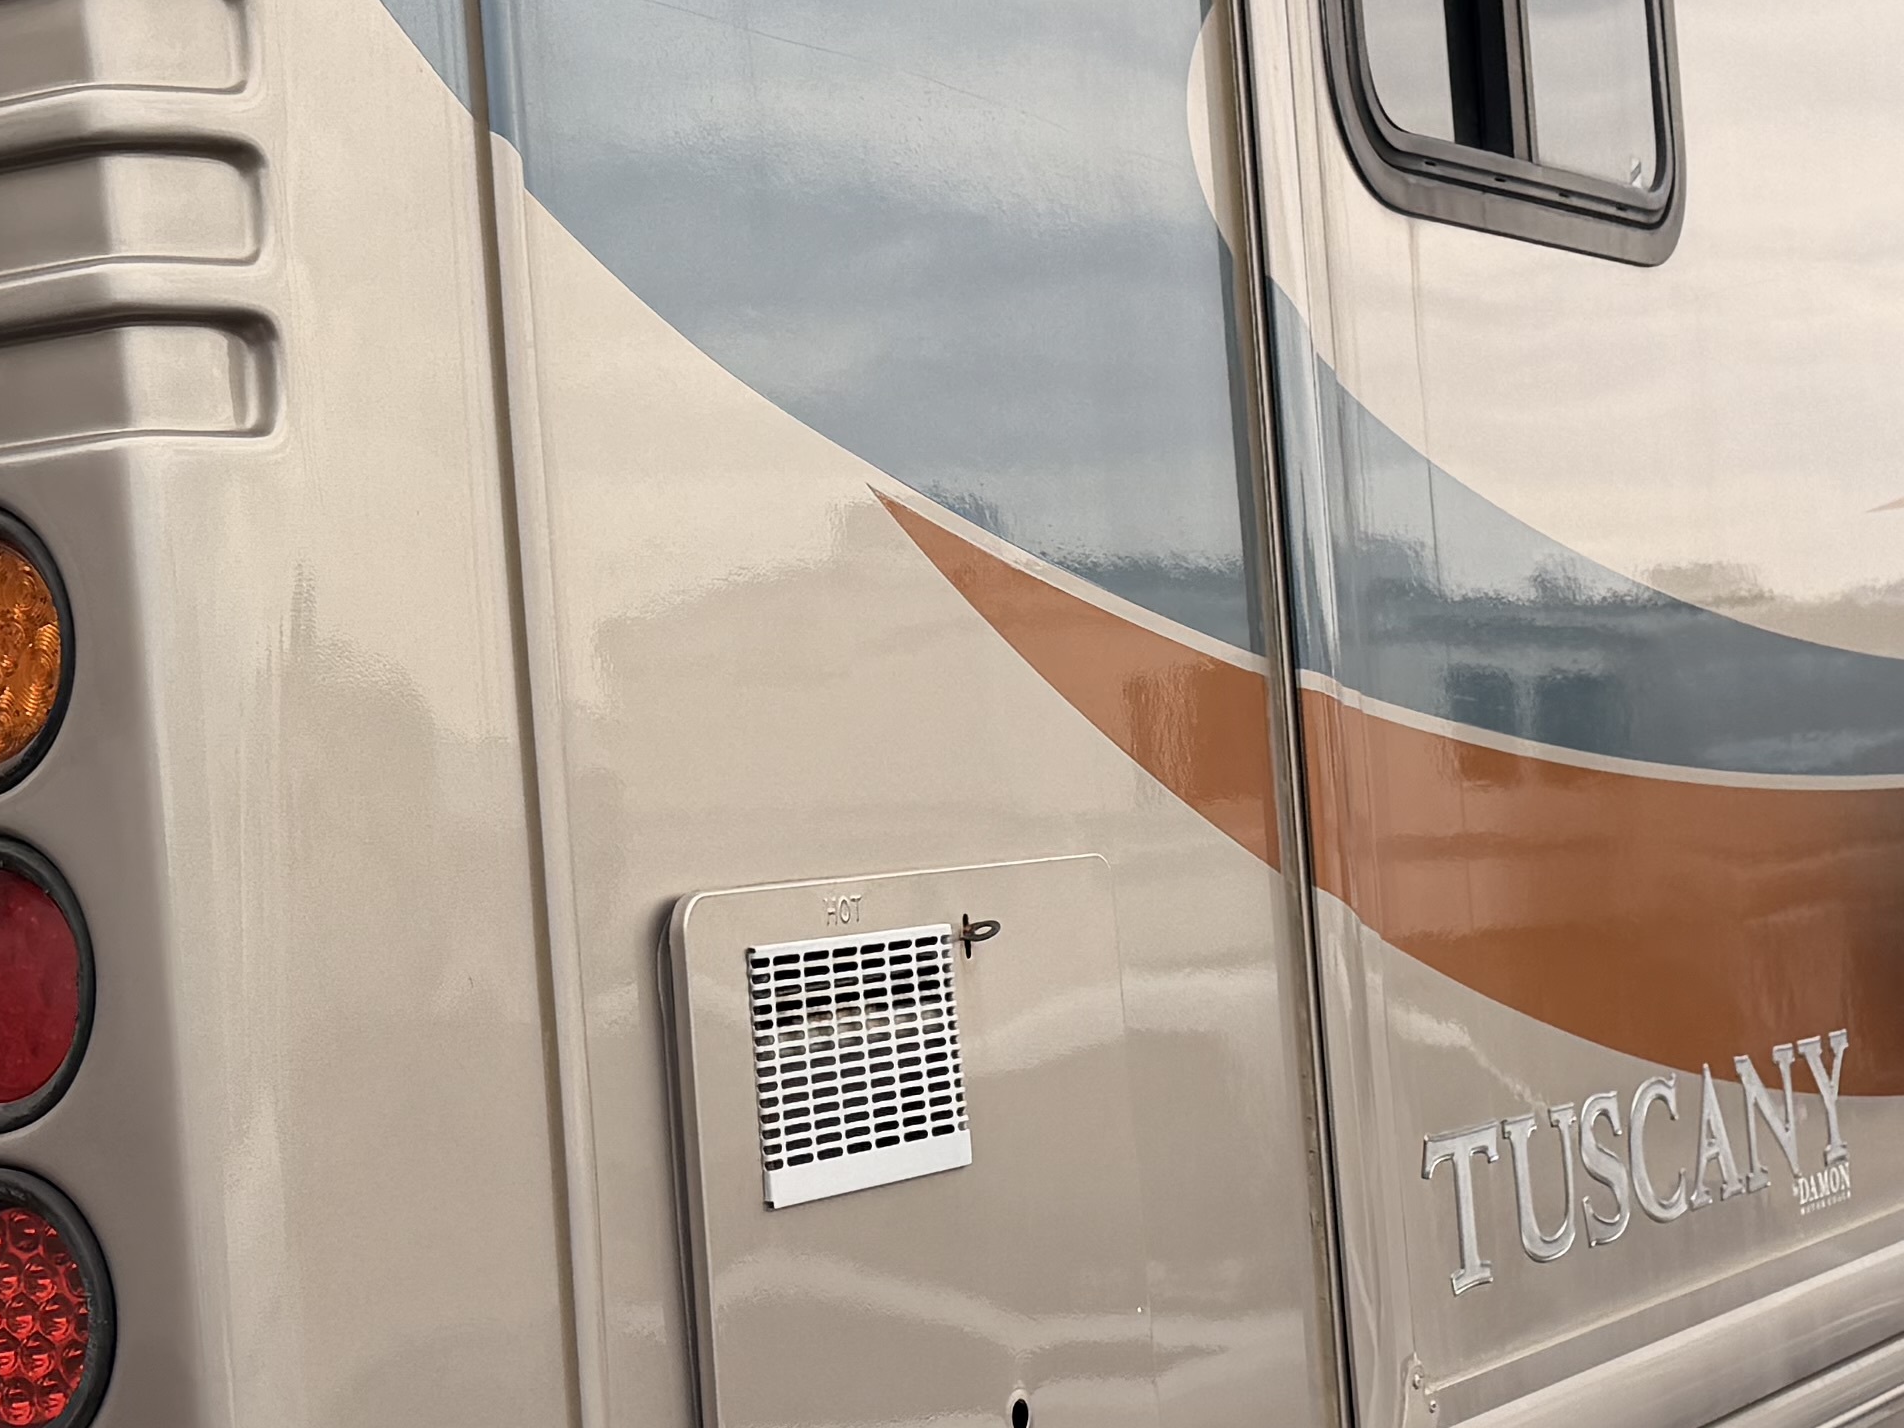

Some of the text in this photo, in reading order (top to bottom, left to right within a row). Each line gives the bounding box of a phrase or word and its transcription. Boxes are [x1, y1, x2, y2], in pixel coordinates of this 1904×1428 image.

[822, 894, 862, 926] HOT
[1421, 1028, 1849, 1296] TUSCANY
[1798, 1162, 1851, 1205] DAMON
